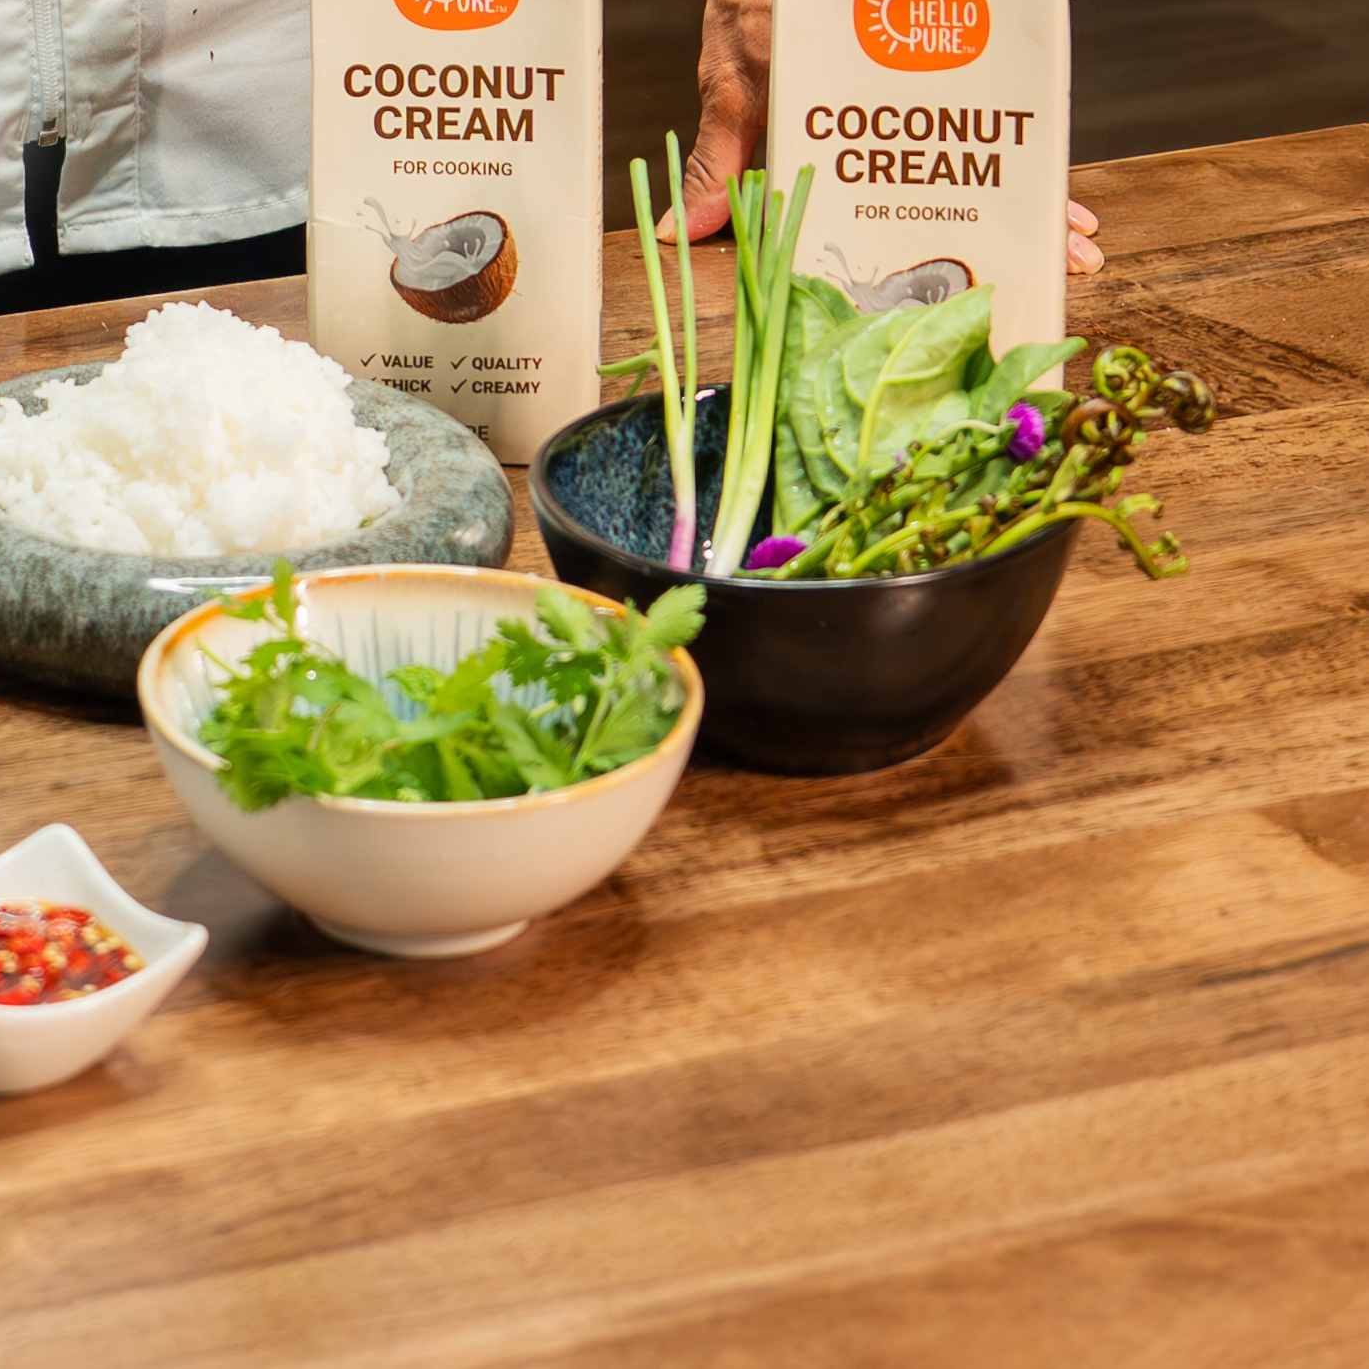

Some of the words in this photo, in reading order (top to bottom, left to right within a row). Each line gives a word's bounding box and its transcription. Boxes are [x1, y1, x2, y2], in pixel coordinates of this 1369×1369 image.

[909, 0, 978, 28] HELLO
[344, 63, 565, 101] COCONUT
[373, 105, 534, 142] CREAM
[805, 105, 1034, 146] COCONUT
[393, 160, 427, 175] FOR
[432, 161, 513, 176] COOKING
[835, 149, 1001, 188] CREAM
[855, 204, 890, 220] FOR
[895, 205, 979, 222] COOKING
[381, 355, 434, 368] VALUE
[472, 357, 542, 371] QUALITY
[381, 379, 431, 392] THICK
[472, 380, 540, 394] CREAMY
